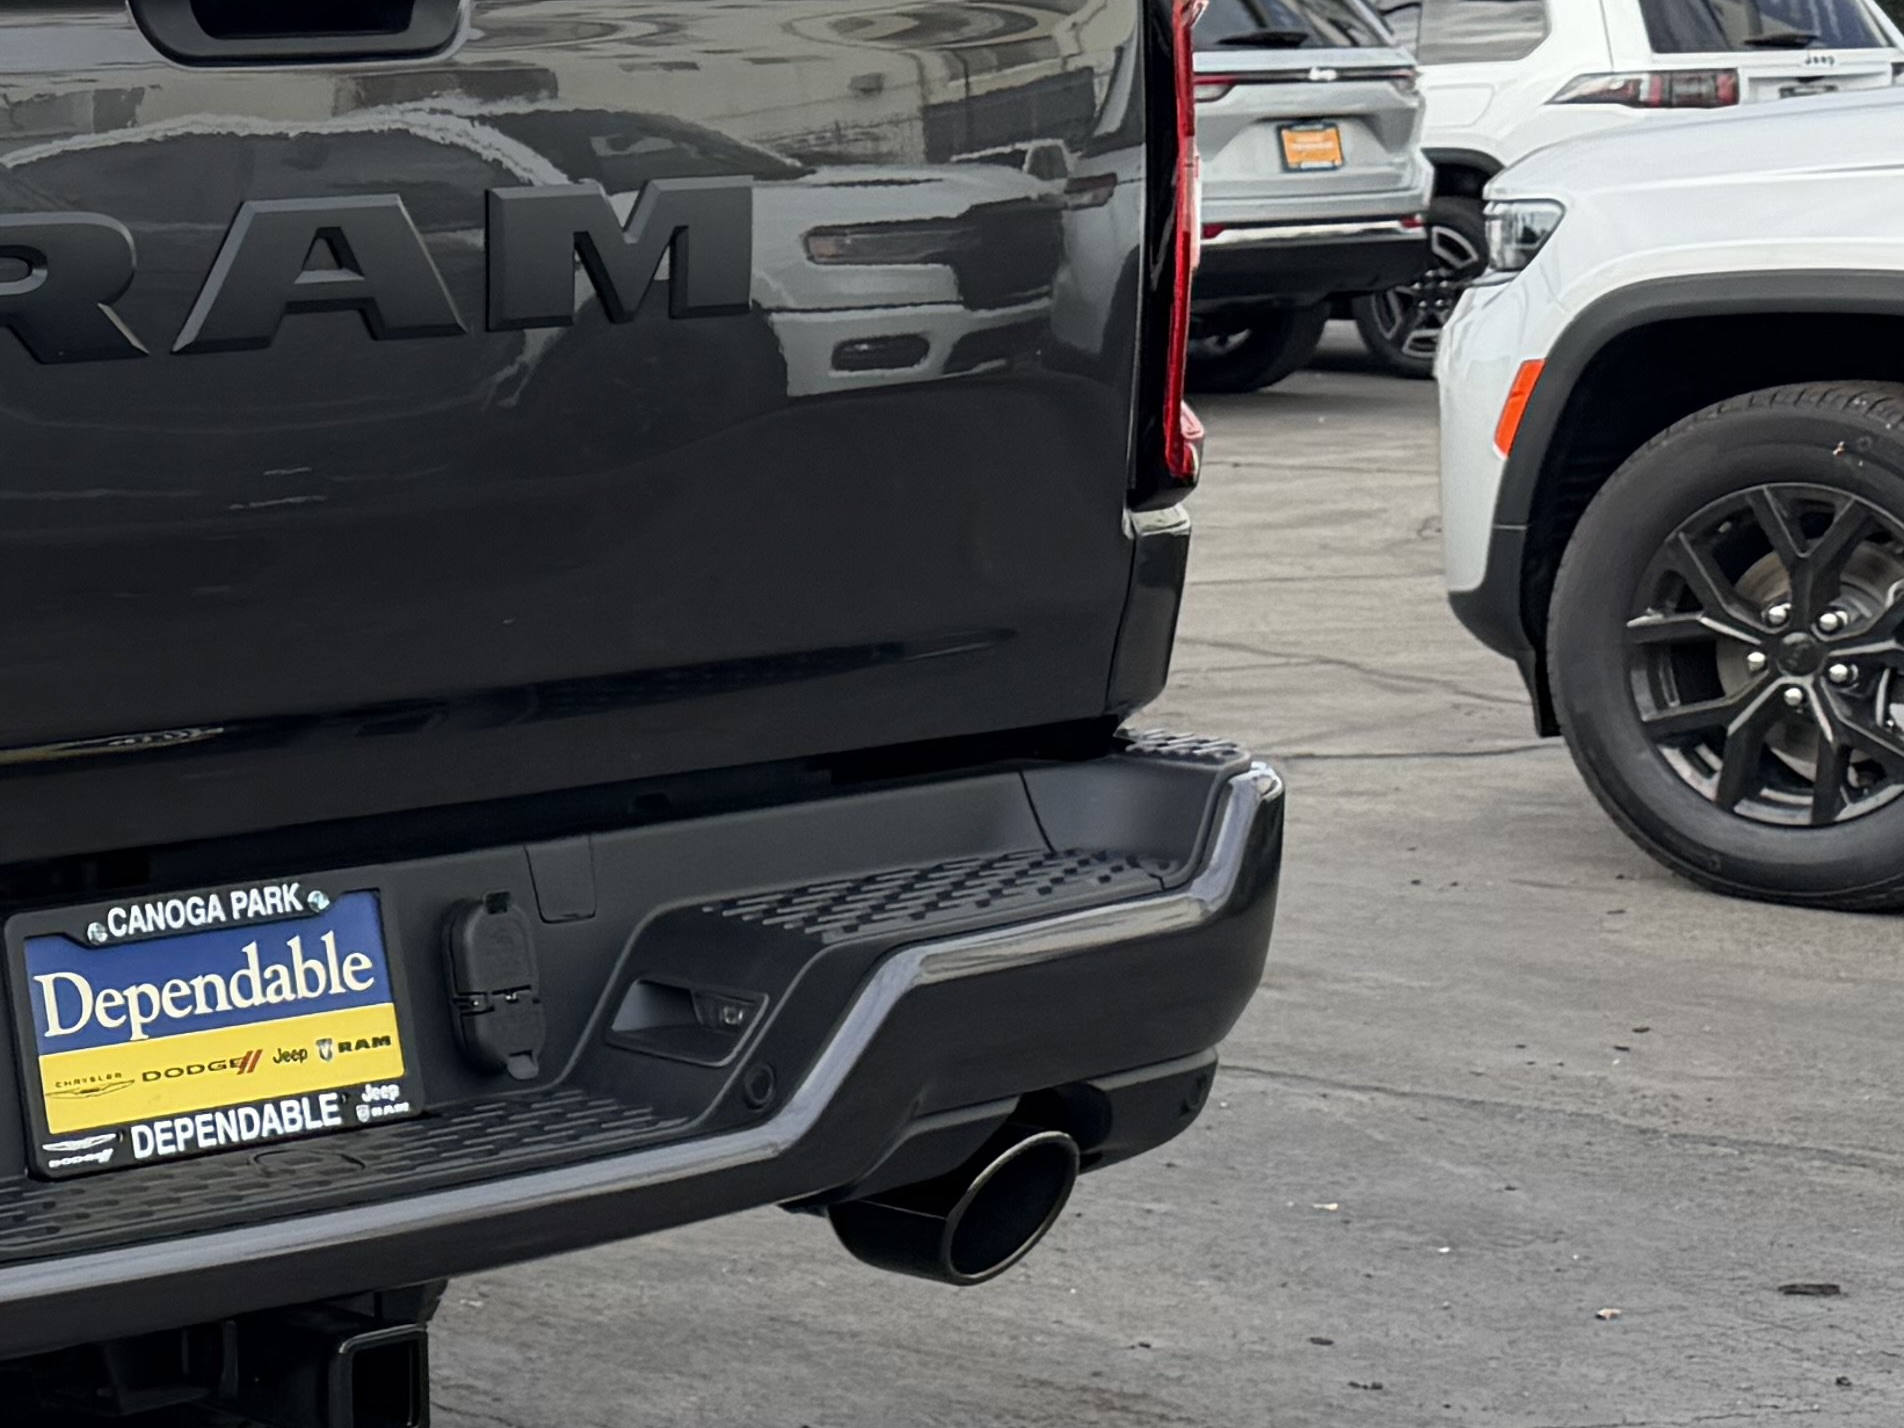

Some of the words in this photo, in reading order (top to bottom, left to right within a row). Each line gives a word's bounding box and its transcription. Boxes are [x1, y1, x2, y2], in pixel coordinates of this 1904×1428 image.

[107, 893, 226, 937] CANOGA
[230, 882, 304, 920] PARK
[33, 930, 375, 1041] Dependable
[55, 1072, 122, 1088] CHRYSLER
[142, 1056, 245, 1082] DODGE
[272, 1047, 309, 1064] Jeep
[338, 1035, 391, 1053] RAM
[361, 1084, 400, 1103] Jeep
[131, 1092, 342, 1159] DEPENDABLE
